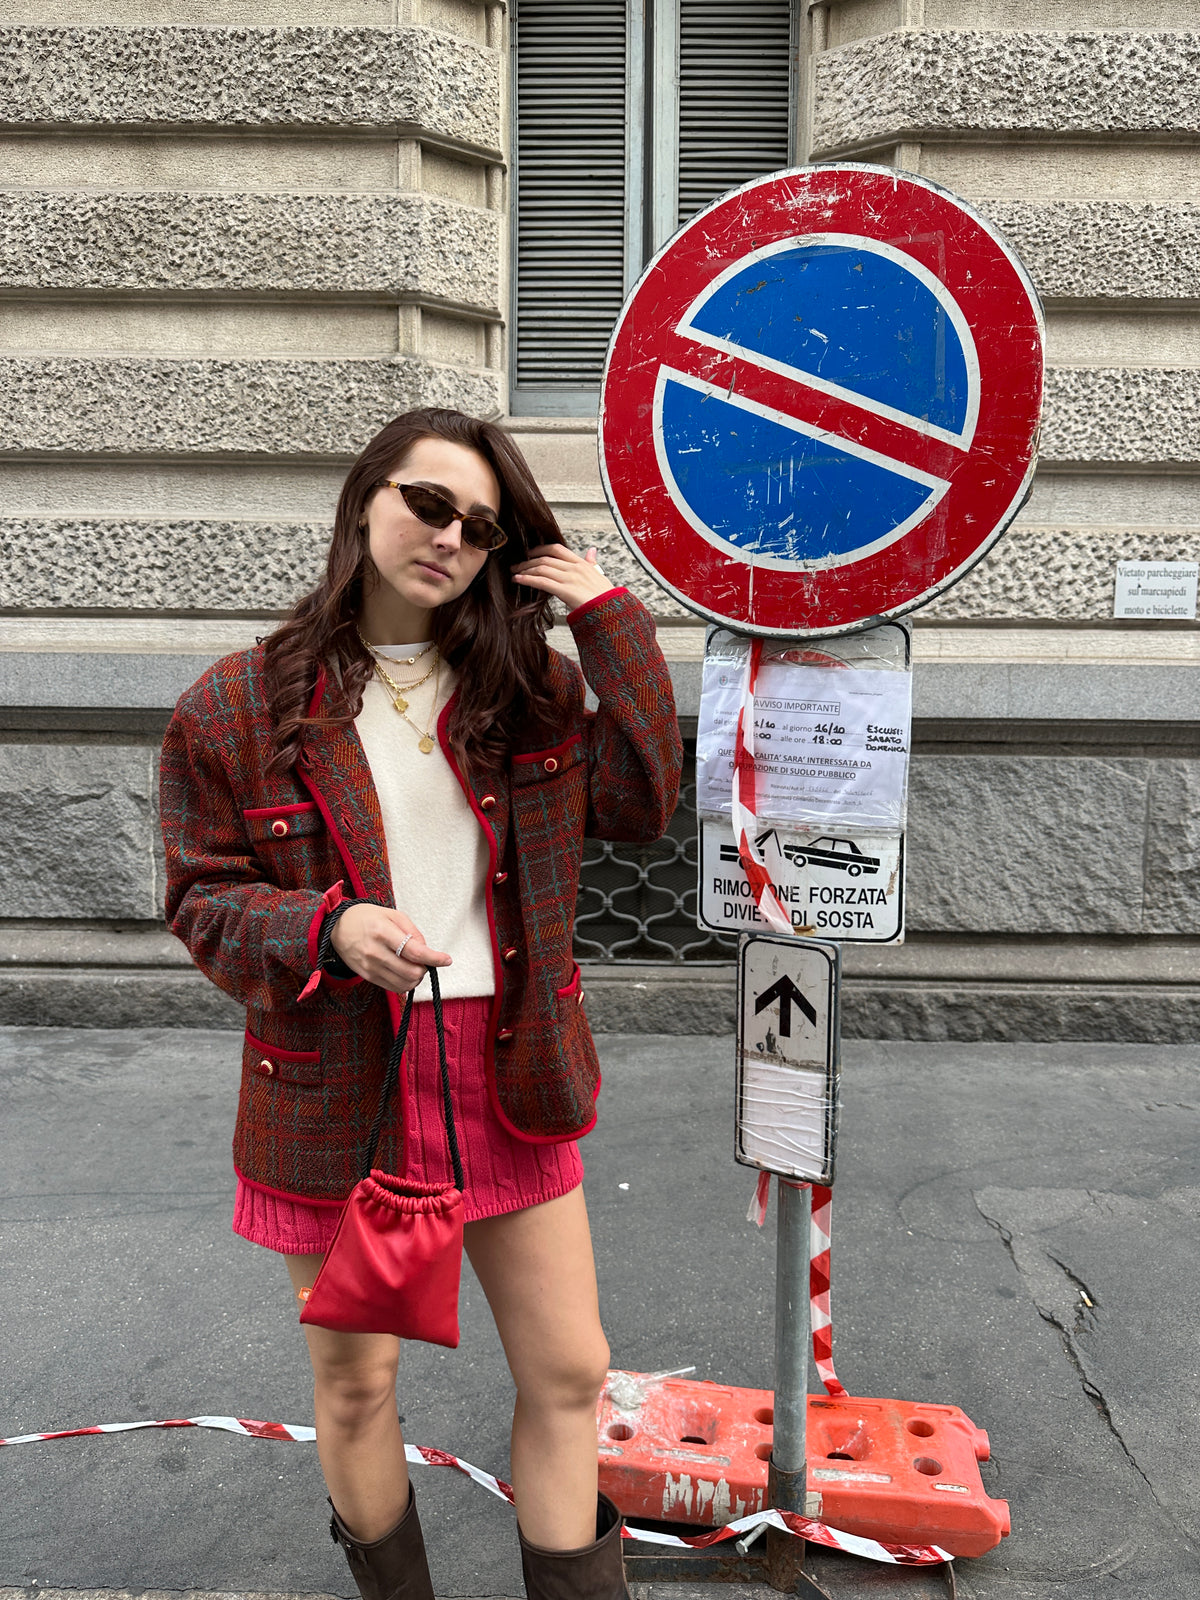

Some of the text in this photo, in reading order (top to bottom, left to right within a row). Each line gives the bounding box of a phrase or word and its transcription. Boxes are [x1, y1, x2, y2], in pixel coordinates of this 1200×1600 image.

[1118, 567, 1197, 580] Vietato parcheggiare
[1128, 586, 1187, 599] sul marciapiedi
[1124, 606, 1145, 615] moto
[1153, 605, 1188, 615] biciclette
[754, 701, 839, 714] AVVISO IMPORTANTE
[814, 722, 845, 735] 16/10
[780, 735, 793, 743] alle
[812, 735, 843, 745] 18:00
[866, 735, 902, 744] SABATO
[865, 743, 907, 753] DOMENICA
[807, 757, 858, 767] INTERESSATA
[789, 768, 816, 776] SUOLO
[818, 770, 857, 779] PUBBLICO
[713, 878, 888, 905] RIMOZONE FORZATA
[724, 902, 874, 929] DIVIE DI SOSTA
